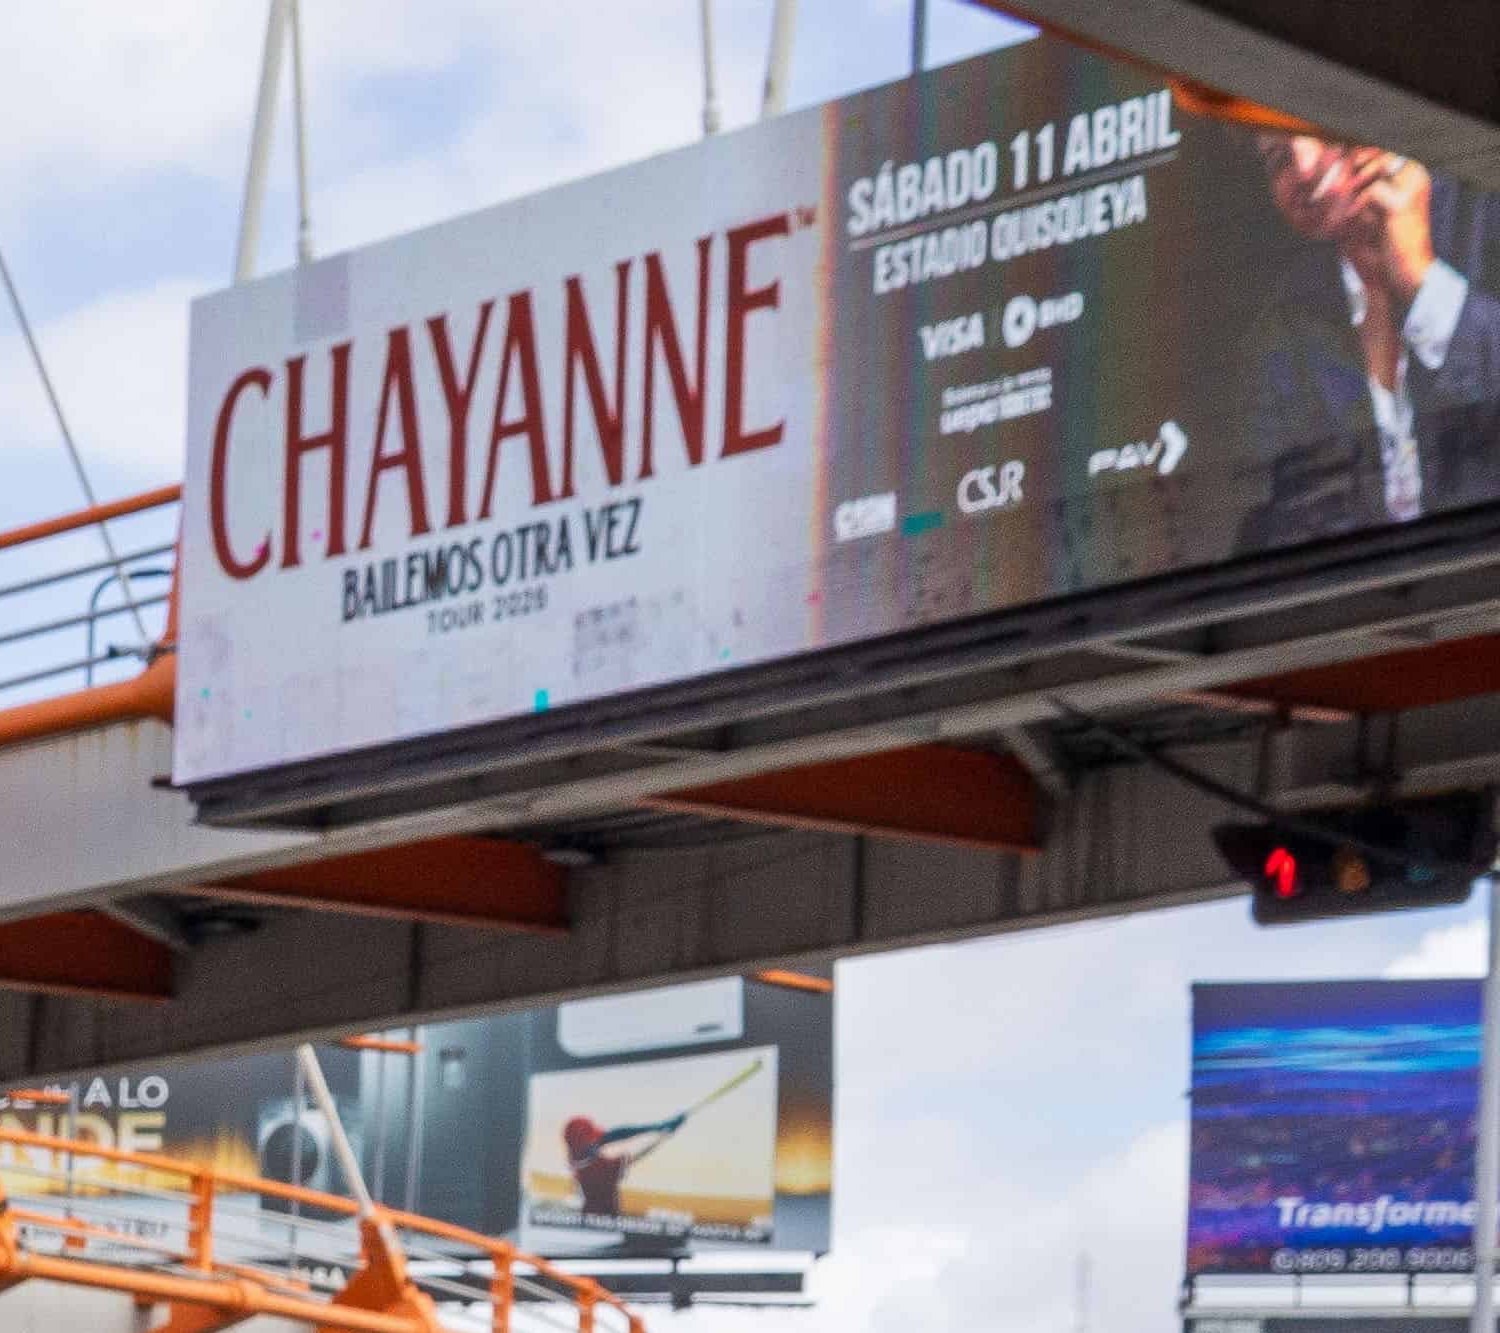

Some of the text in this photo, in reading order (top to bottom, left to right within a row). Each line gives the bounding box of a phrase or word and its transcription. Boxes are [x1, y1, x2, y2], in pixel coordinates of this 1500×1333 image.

[846, 89, 1181, 238] SÁBADO 11 ABRIL
[873, 175, 1148, 295] ESTADIO QUISQUEYA
[208, 211, 792, 581] CHAYANNE
[919, 311, 985, 361] VISA
[341, 497, 645, 623] BAILEMOS OTRA VEZ
[426, 599, 485, 633] TOUR
[118, 1075, 170, 1109] LO
